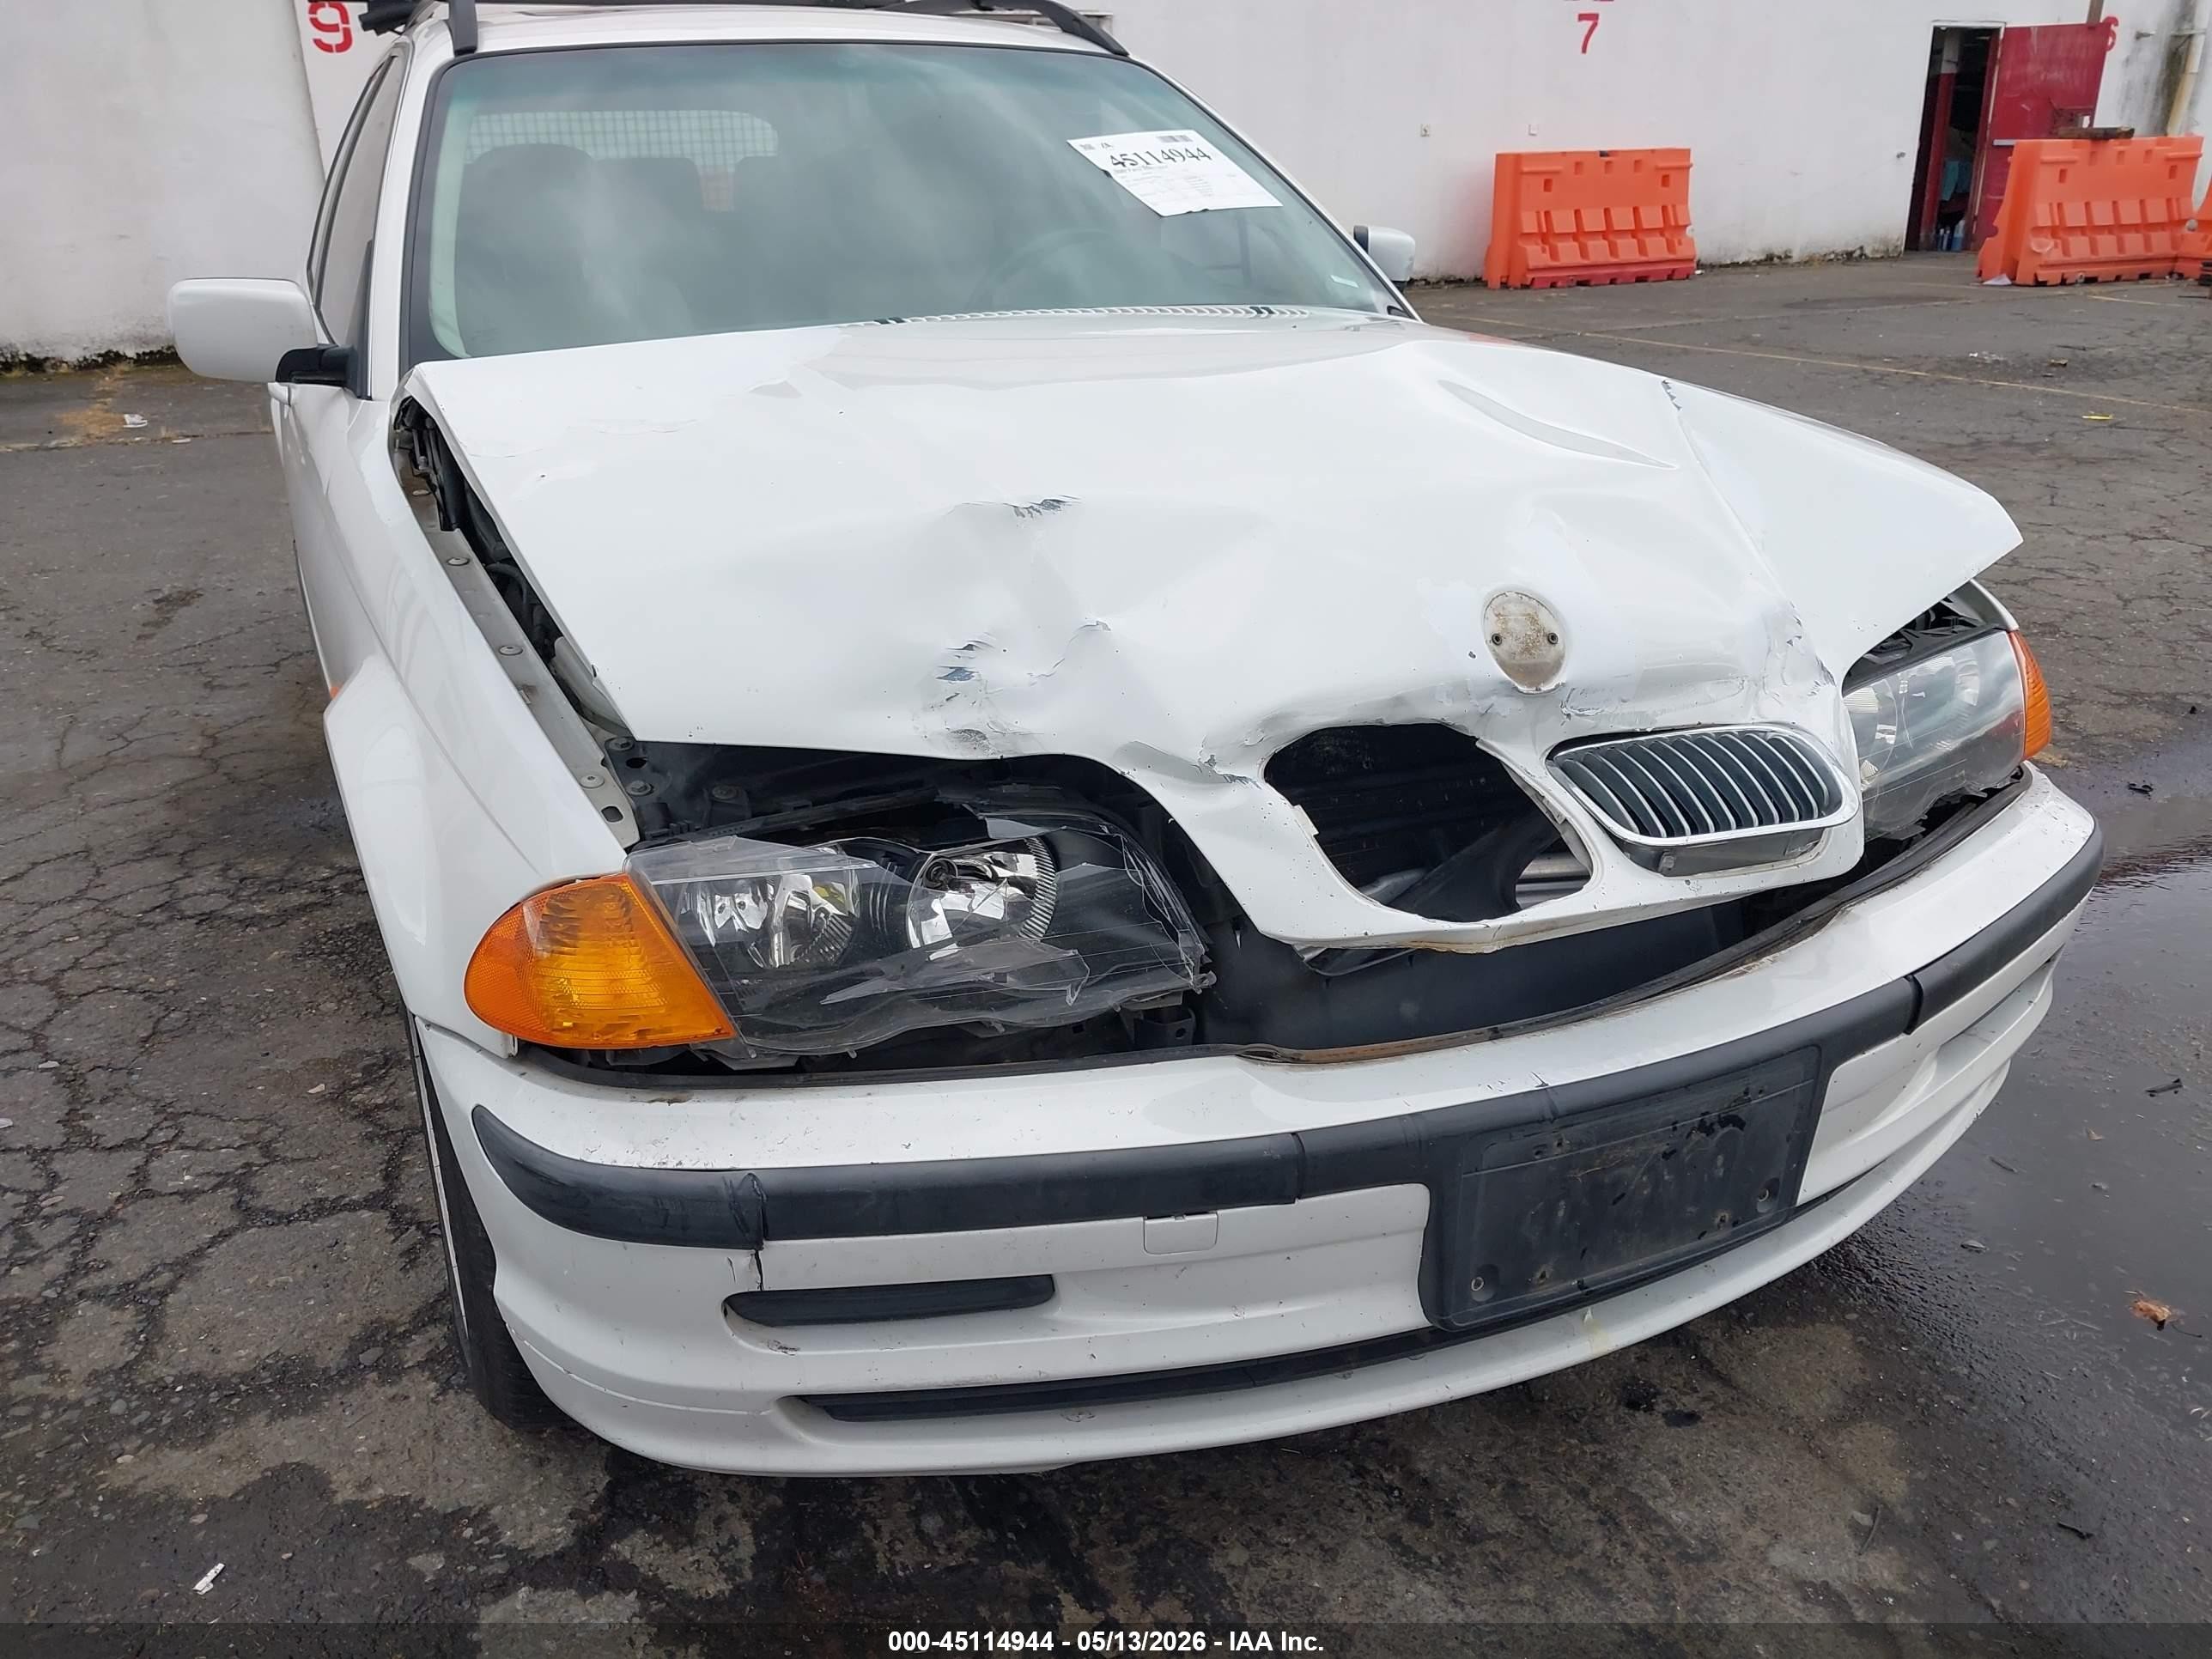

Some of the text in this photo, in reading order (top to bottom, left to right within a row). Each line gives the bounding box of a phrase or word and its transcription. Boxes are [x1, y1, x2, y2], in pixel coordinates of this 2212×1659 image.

[308, 1, 353, 53] 9
[1577, 13, 1599, 53] 7
[1110, 148, 1212, 167] 45114944
